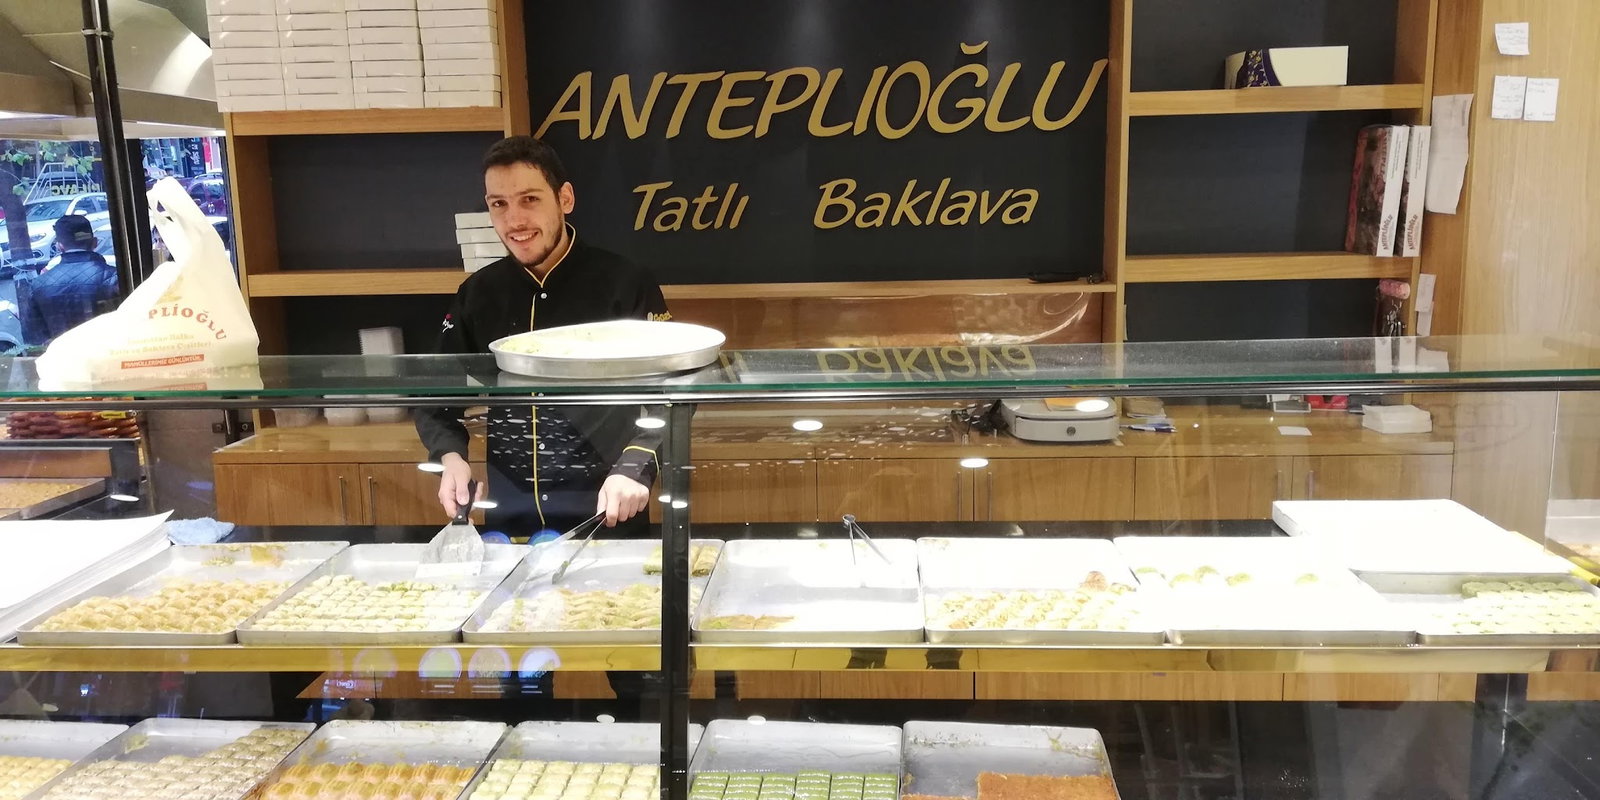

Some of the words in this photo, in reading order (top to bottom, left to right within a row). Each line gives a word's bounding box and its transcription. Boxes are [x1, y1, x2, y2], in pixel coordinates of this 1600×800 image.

[532, 40, 1109, 140] ANTEPLIOĞLU
[632, 182, 749, 232] Tatlı
[814, 178, 1039, 229] Baklava
